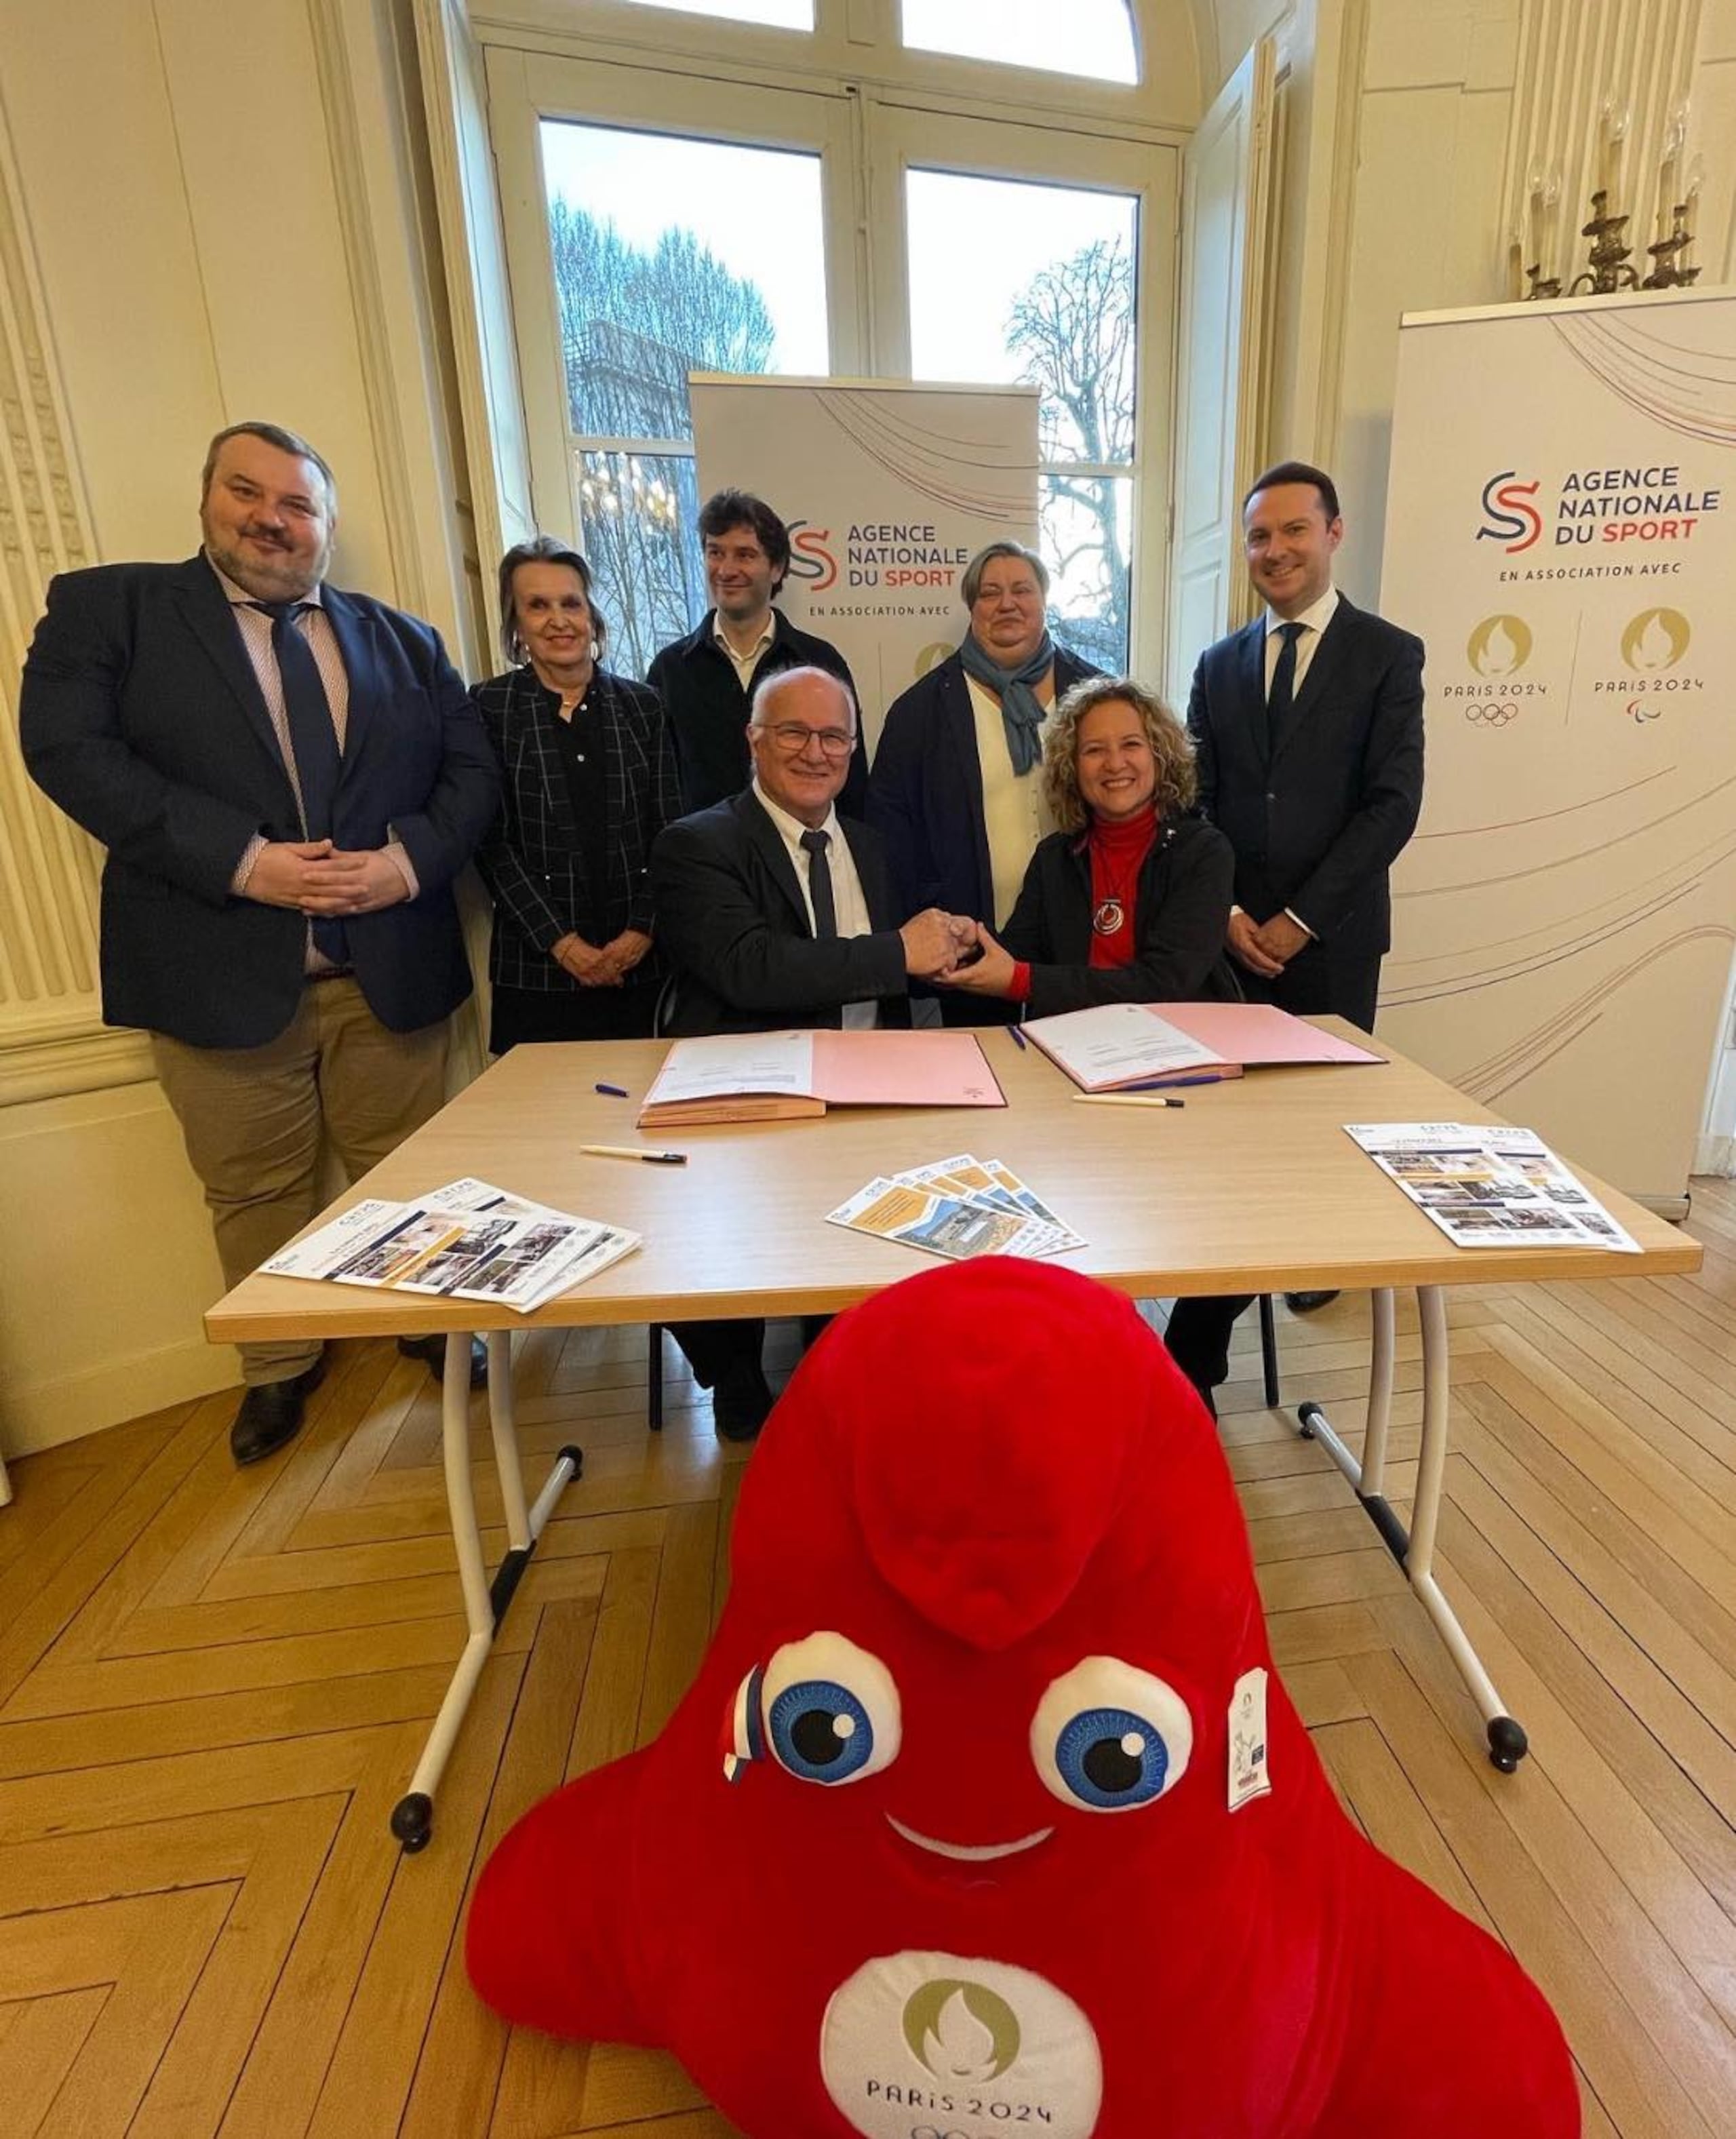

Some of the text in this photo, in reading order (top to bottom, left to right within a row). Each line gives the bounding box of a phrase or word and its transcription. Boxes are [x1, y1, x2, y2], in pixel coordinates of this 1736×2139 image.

[1562, 467, 1679, 493] AGENCE
[1558, 490, 1721, 519] NATIONALE
[848, 524, 935, 542] AGENCE
[1555, 518, 1698, 545] DU SPORT
[848, 547, 968, 564] NATIONALE
[850, 570, 955, 587] DU SPORT
[1499, 562, 1682, 582] EN ASSOCIATION AVEC
[810, 606, 950, 616] EN ASSOCIATION AVEC
[1499, 684, 1547, 696] 2024
[1653, 678, 1703, 691] 2024
[968, 2099, 1051, 2123] 2024
